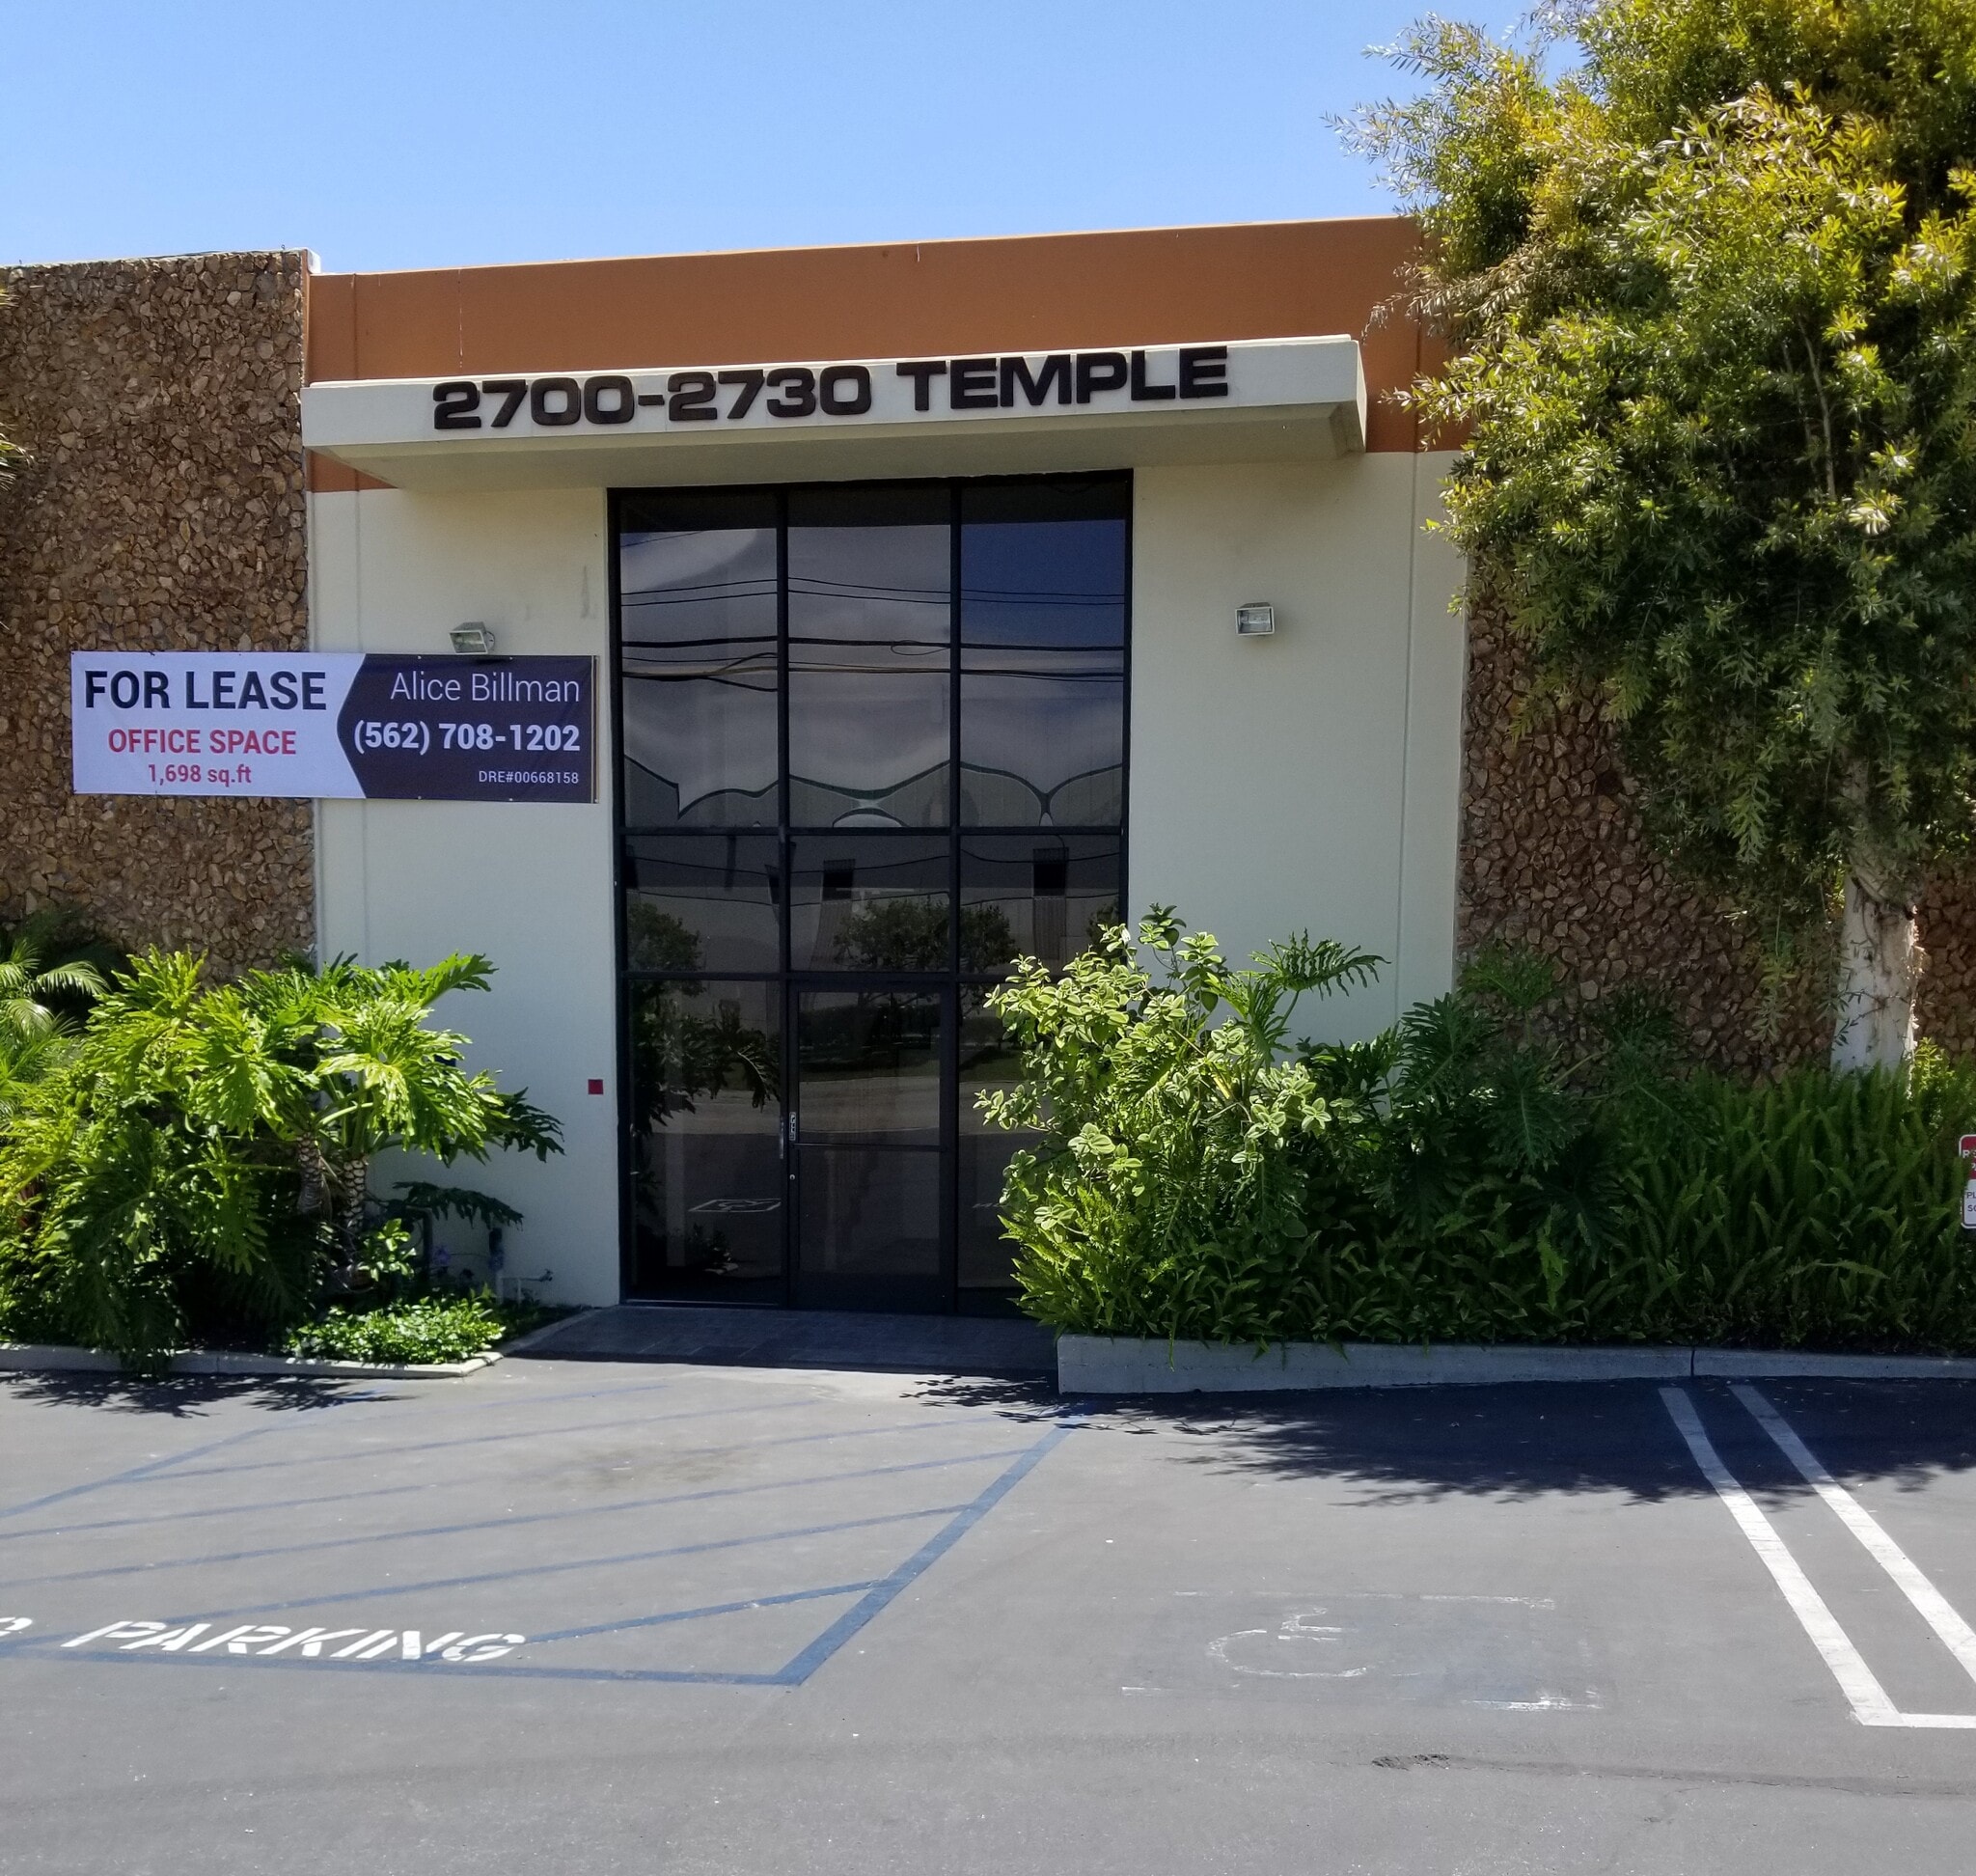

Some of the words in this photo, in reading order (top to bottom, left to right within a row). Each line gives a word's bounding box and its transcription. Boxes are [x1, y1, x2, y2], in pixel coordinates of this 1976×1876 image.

[432, 366, 872, 430] 2700-2730
[895, 345, 1229, 412] TEMPLE
[85, 670, 171, 709] FOR
[185, 671, 327, 710] LEASE
[390, 672, 461, 702] Alice
[471, 673, 581, 703] Billman
[108, 729, 201, 755] OFFICE
[208, 730, 297, 756] SPACE
[353, 720, 430, 756] (562)
[438, 723, 581, 752] 708-1202
[148, 763, 202, 785] 1,698
[206, 763, 252, 786] sq.ft
[478, 770, 579, 785] DRE#00668158
[61, 1620, 526, 1662] PARKING
